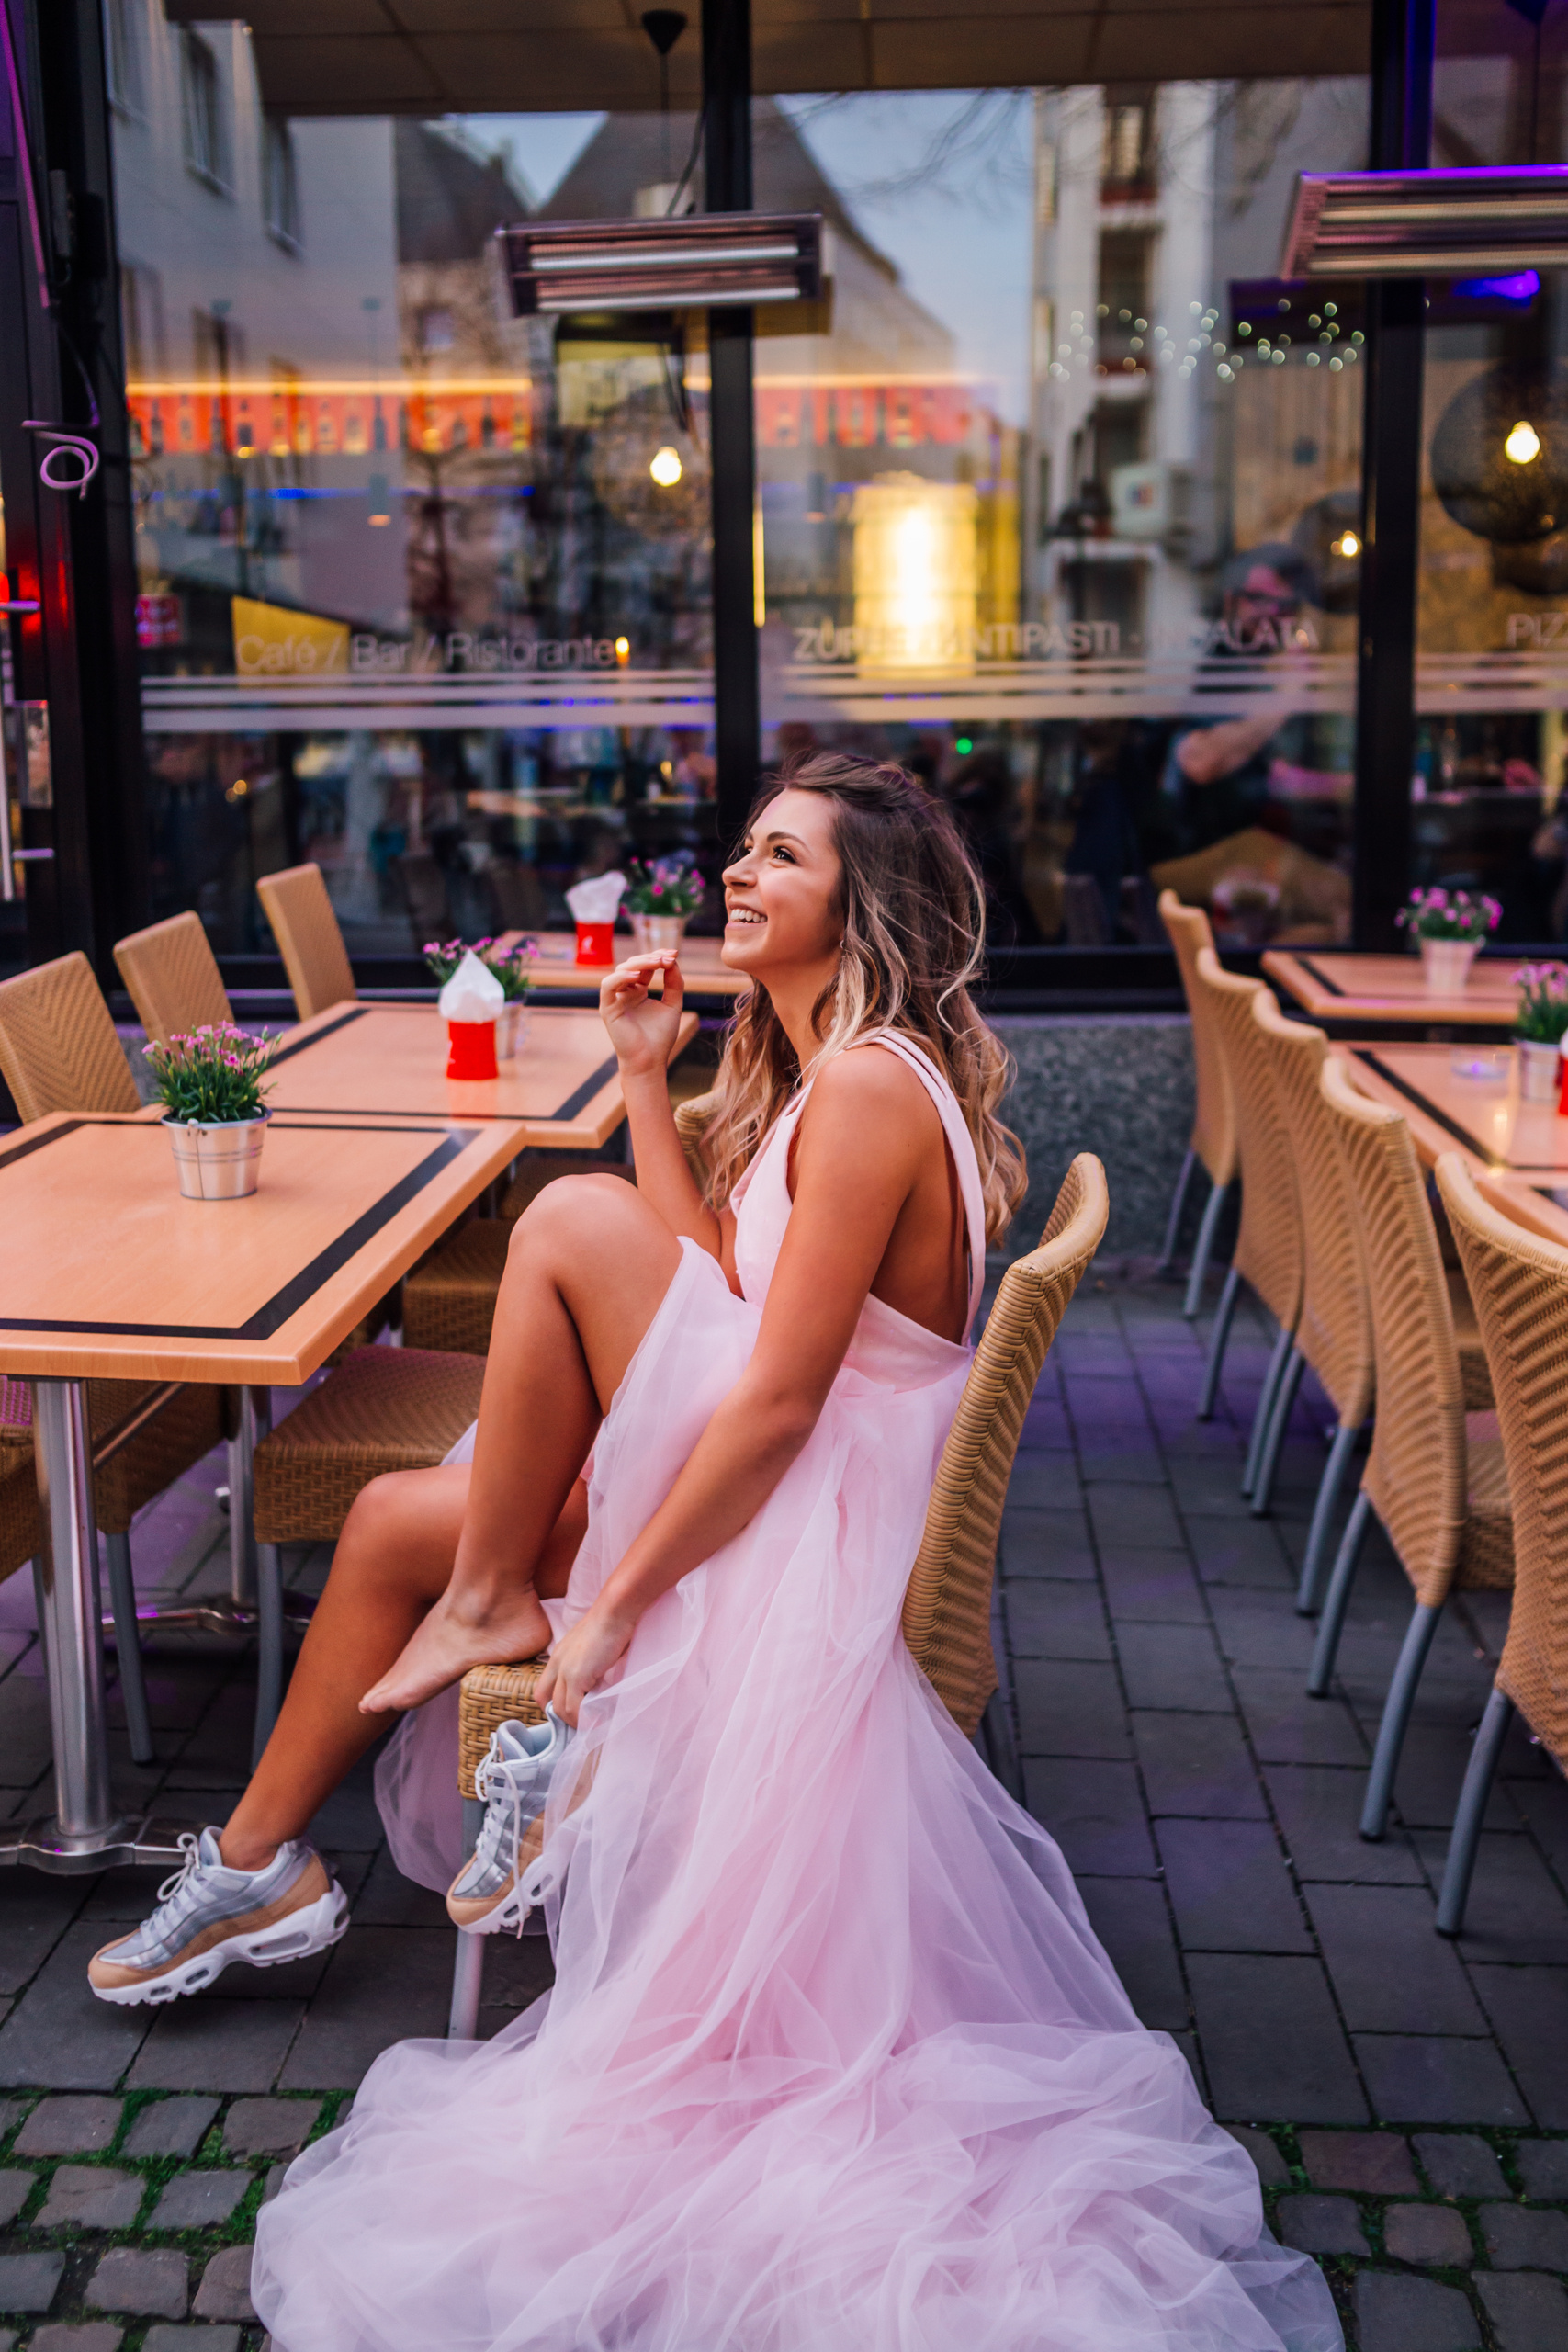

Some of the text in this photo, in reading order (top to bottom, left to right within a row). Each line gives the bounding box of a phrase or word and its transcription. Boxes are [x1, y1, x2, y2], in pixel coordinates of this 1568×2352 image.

[236, 633, 317, 672] Café
[351, 633, 411, 671] Bar
[447, 632, 617, 670] Ristorante
[1151, 616, 1321, 653] ALATA
